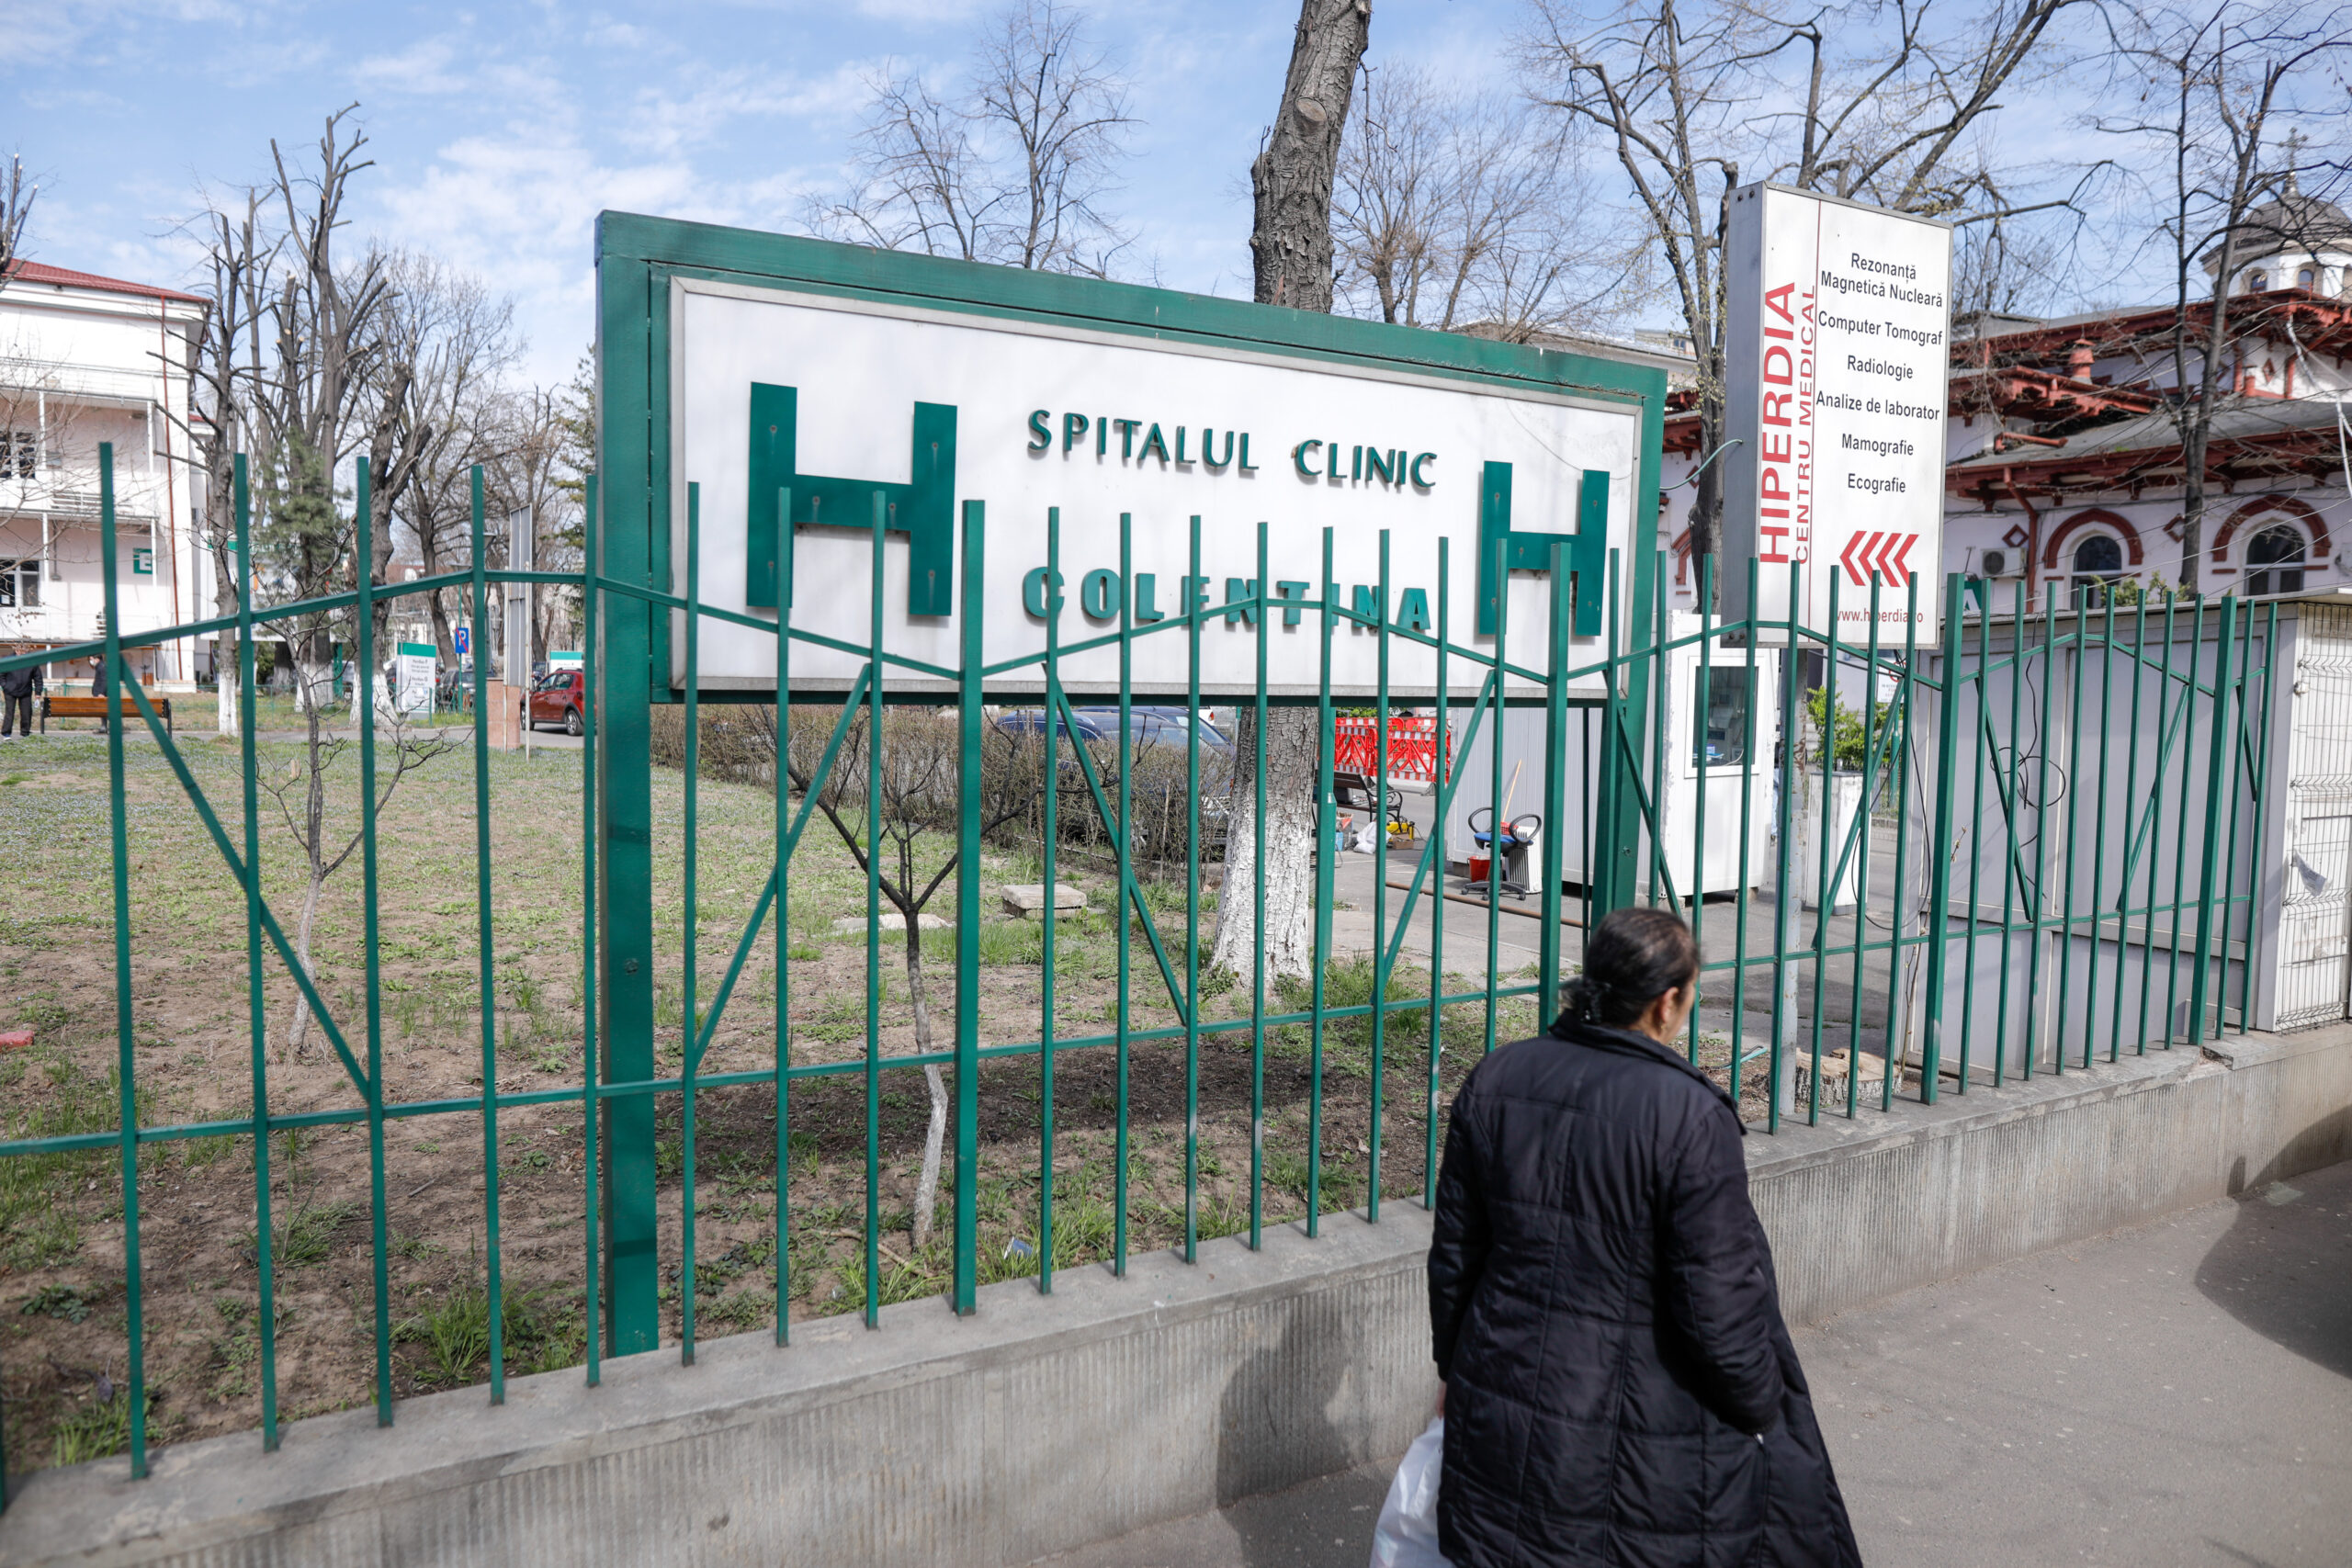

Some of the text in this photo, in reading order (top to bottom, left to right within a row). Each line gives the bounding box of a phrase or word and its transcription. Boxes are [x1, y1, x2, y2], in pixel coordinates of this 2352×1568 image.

[1850, 253, 1917, 283] Rezonanță
[1821, 270, 1942, 307] Magnetică Nucleară
[1818, 310, 1942, 346] Computer Tomograf
[1848, 355, 1914, 381] Radiologie
[1759, 282, 1795, 563] HIPERDIA
[1816, 390, 1940, 420] Analize de laborator
[1795, 286, 1815, 564] CENTRU MEDICAL
[1027, 410, 1438, 488] SPITALUL CLINIC
[1841, 434, 1914, 457] Mamografie
[747, 381, 957, 616] H
[1848, 473, 1906, 494] Ecografie
